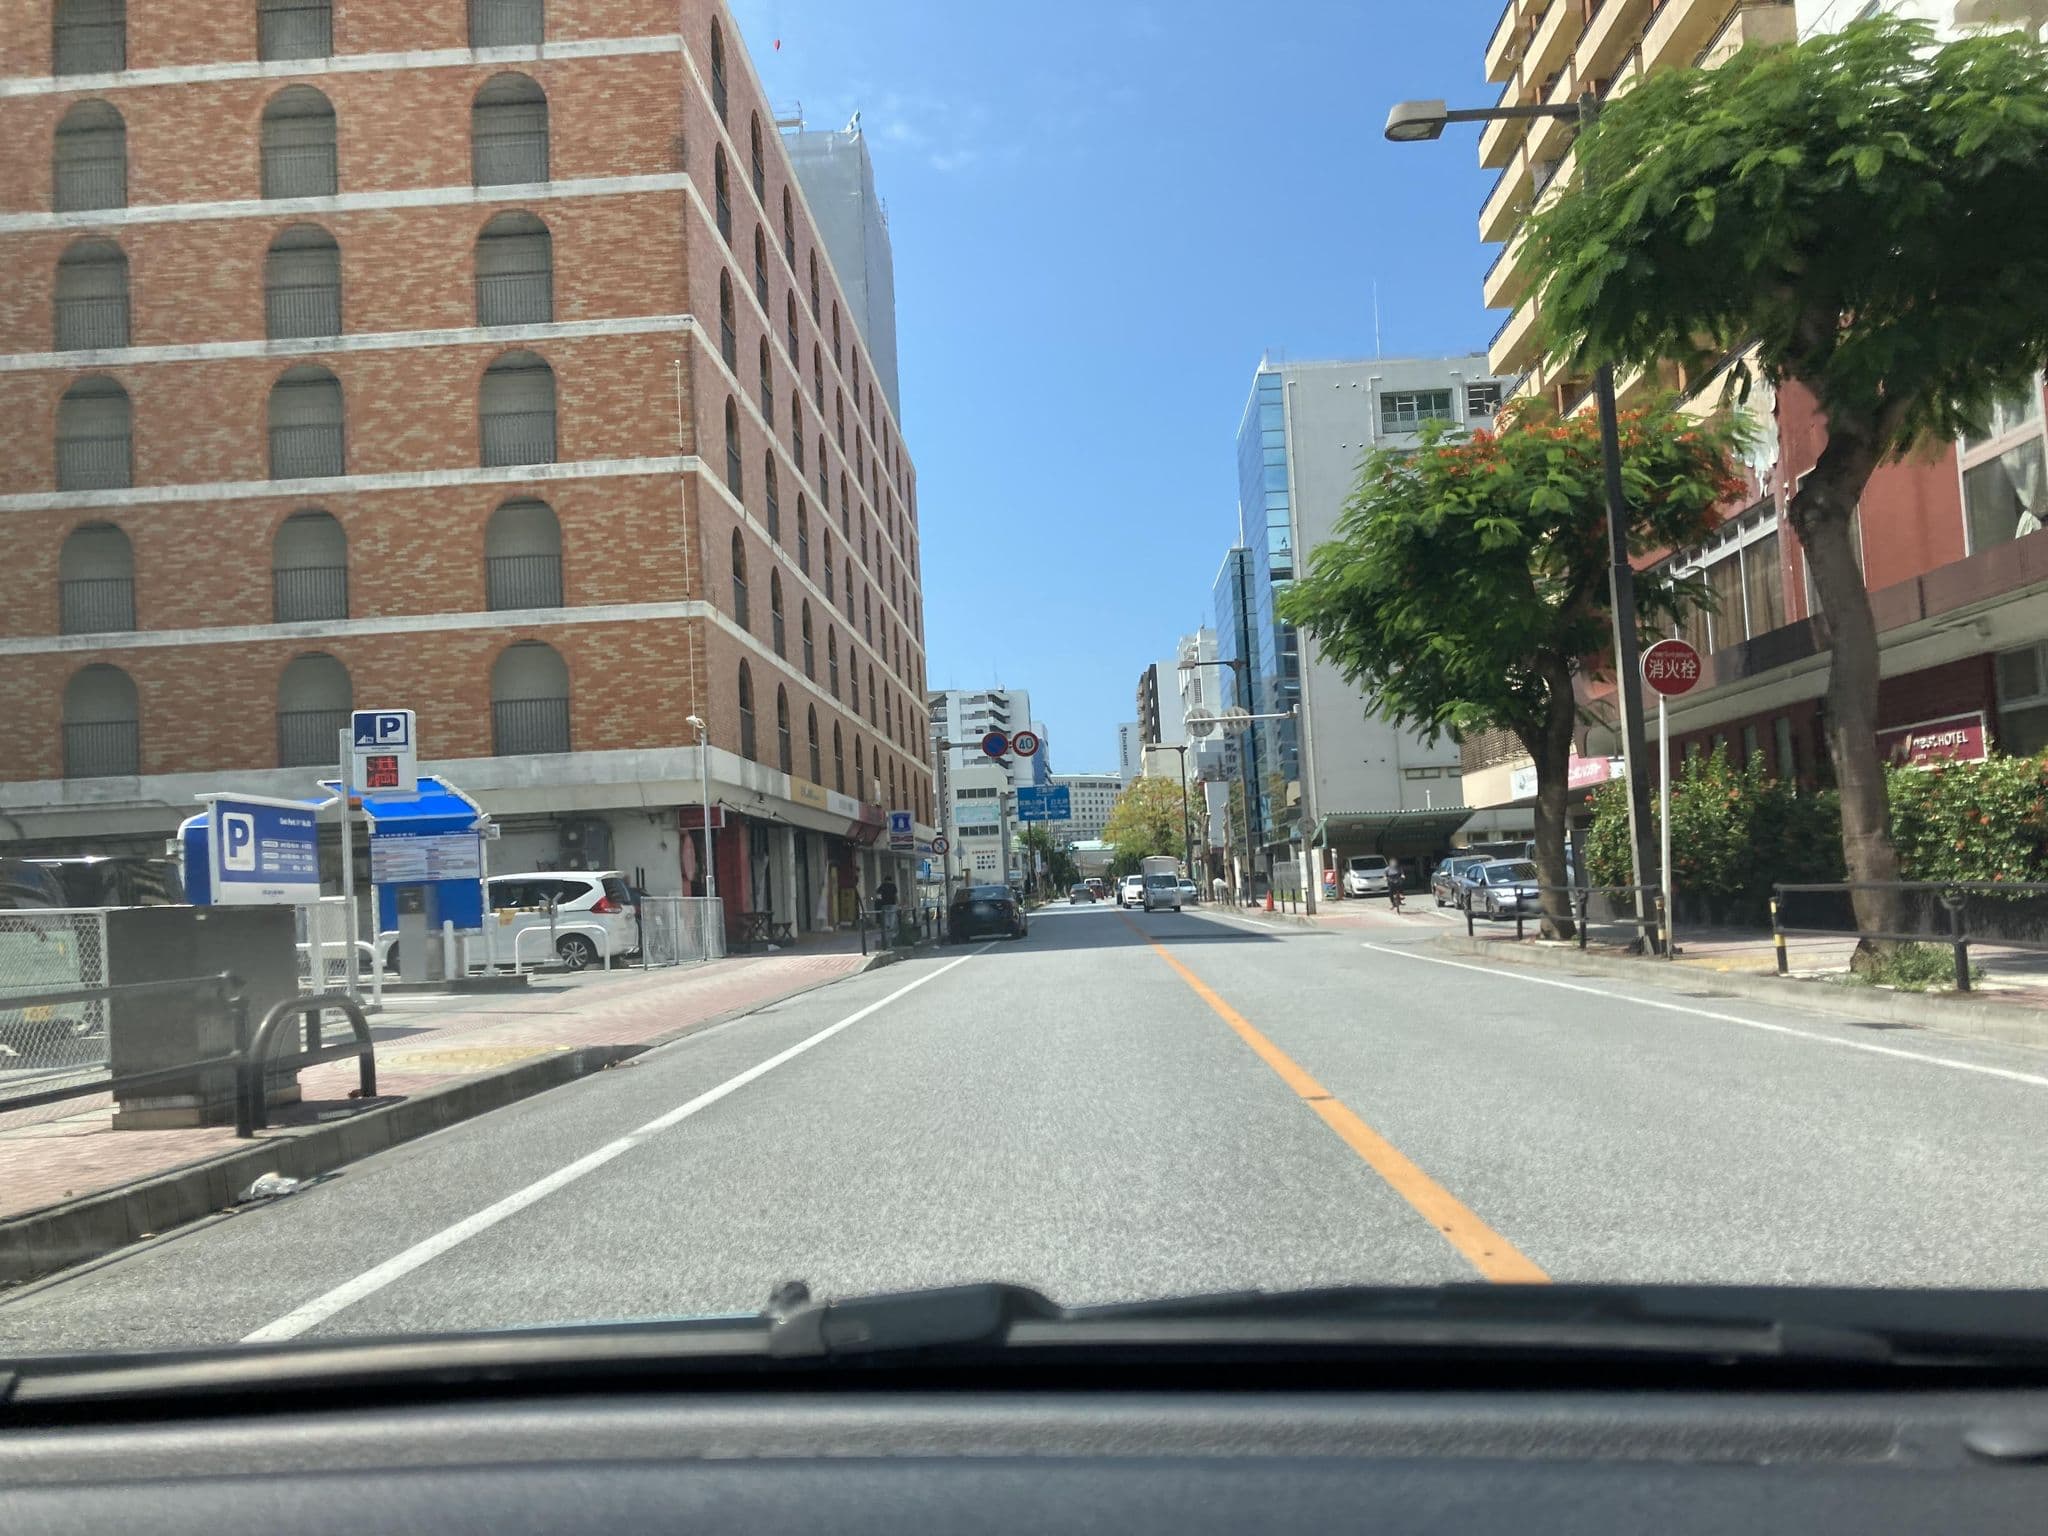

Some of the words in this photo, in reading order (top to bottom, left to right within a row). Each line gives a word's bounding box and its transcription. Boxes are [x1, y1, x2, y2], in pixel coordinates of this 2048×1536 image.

[1649, 659, 1696, 679] 消火栓
[380, 717, 400, 738] P
[1019, 737, 1034, 750] 40
[1938, 729, 1969, 747] HOTEL
[227, 819, 249, 858] P
